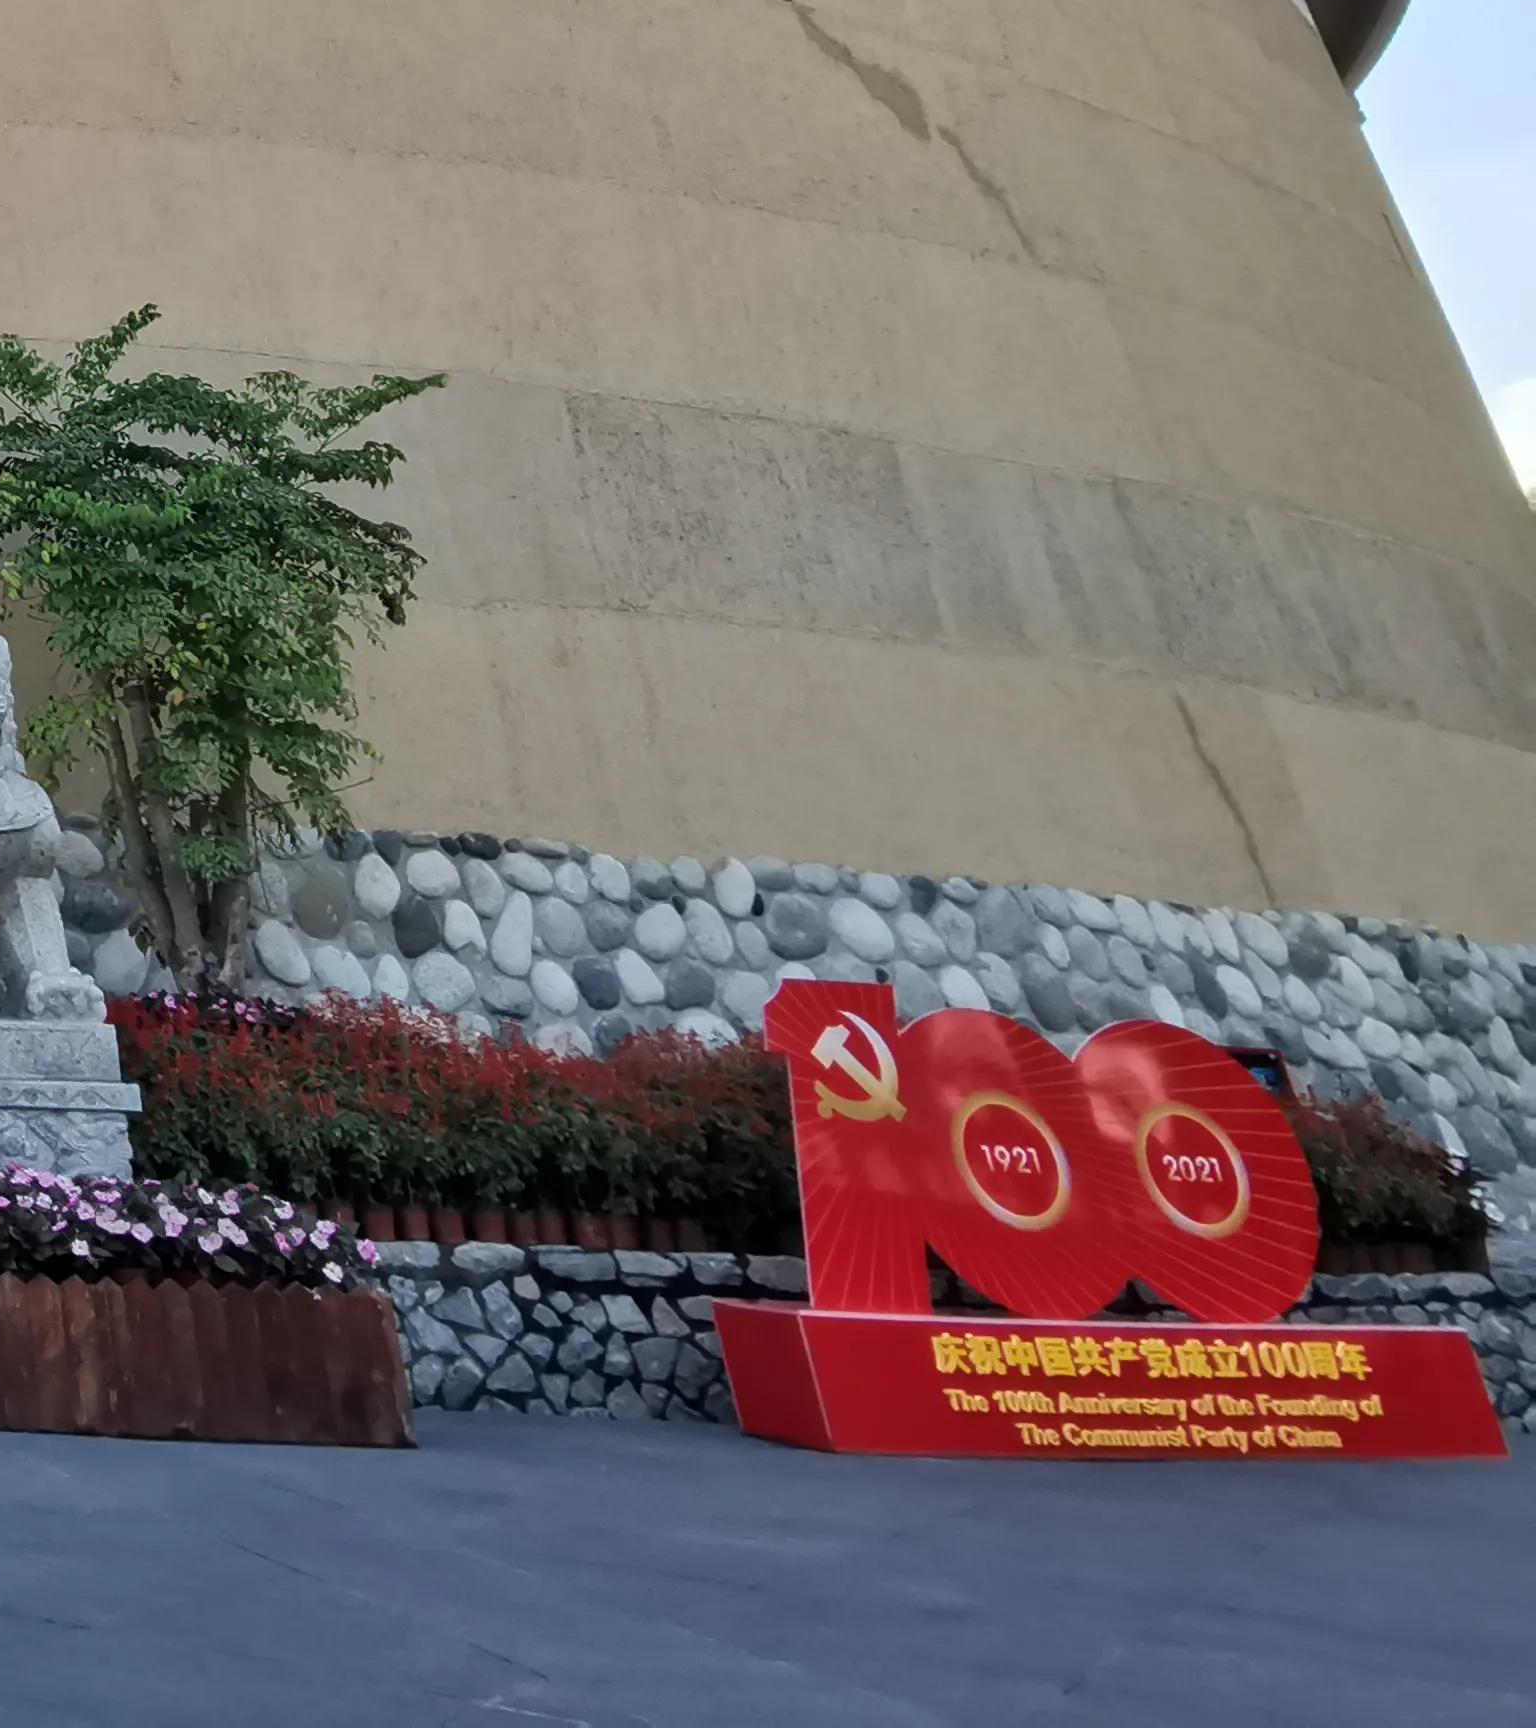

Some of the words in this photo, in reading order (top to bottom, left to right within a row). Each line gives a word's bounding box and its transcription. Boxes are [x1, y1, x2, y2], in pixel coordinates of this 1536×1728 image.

[980, 1144, 1042, 1174] 1921
[1162, 1154, 1224, 1183] 2021
[931, 1332, 1373, 1380] 庆祝中国共产党成立100周年
[943, 1388, 989, 1412] The
[992, 1390, 1056, 1414] 100th
[1059, 1391, 1187, 1421] Anniversary
[1191, 1394, 1216, 1416] of
[1216, 1394, 1255, 1417] the
[1255, 1393, 1360, 1422] Founding
[1359, 1394, 1384, 1416] of
[1016, 1422, 1060, 1446] The
[1062, 1423, 1190, 1447] Communist
[1189, 1424, 1248, 1454] Party
[1252, 1425, 1277, 1447] of
[1278, 1425, 1343, 1448] China
